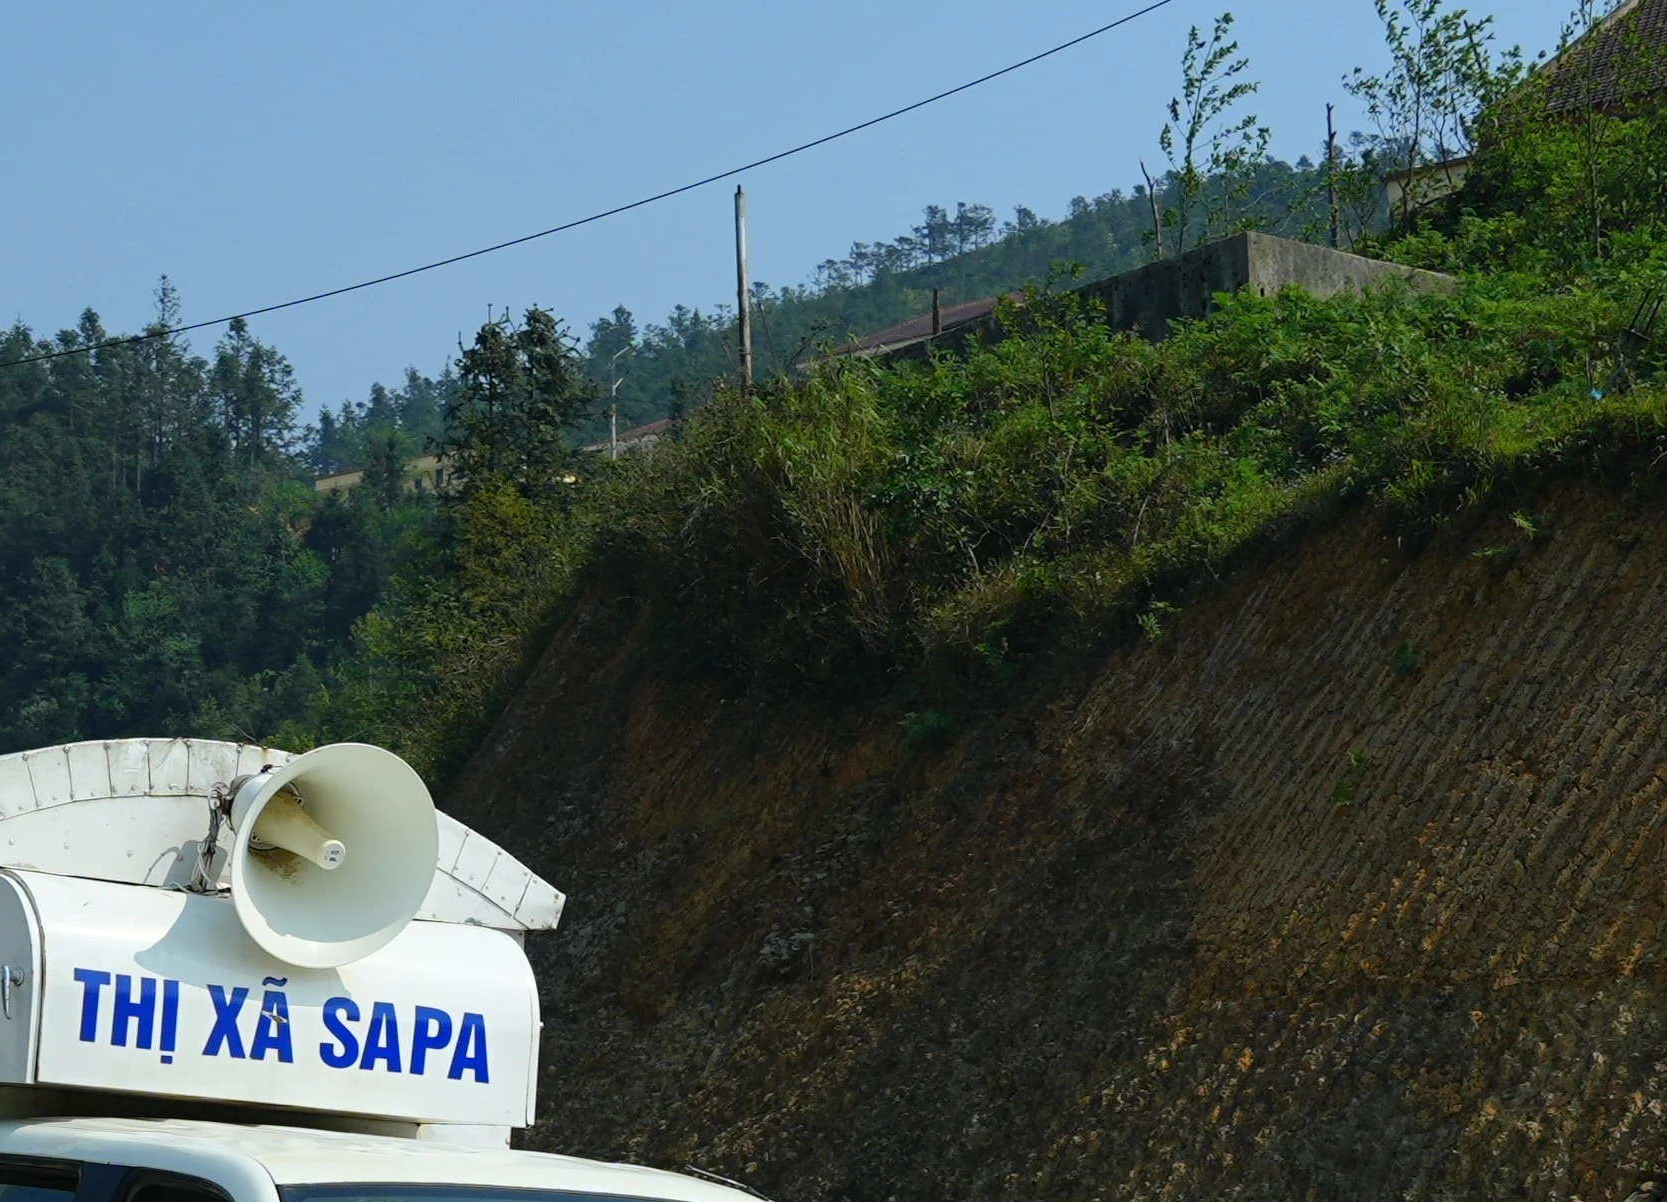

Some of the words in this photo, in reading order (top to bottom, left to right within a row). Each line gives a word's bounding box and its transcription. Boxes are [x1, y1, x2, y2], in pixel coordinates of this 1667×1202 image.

[73, 967, 179, 1064] THỊ
[201, 977, 294, 1064] XÃ
[318, 996, 490, 1084] SAPA
